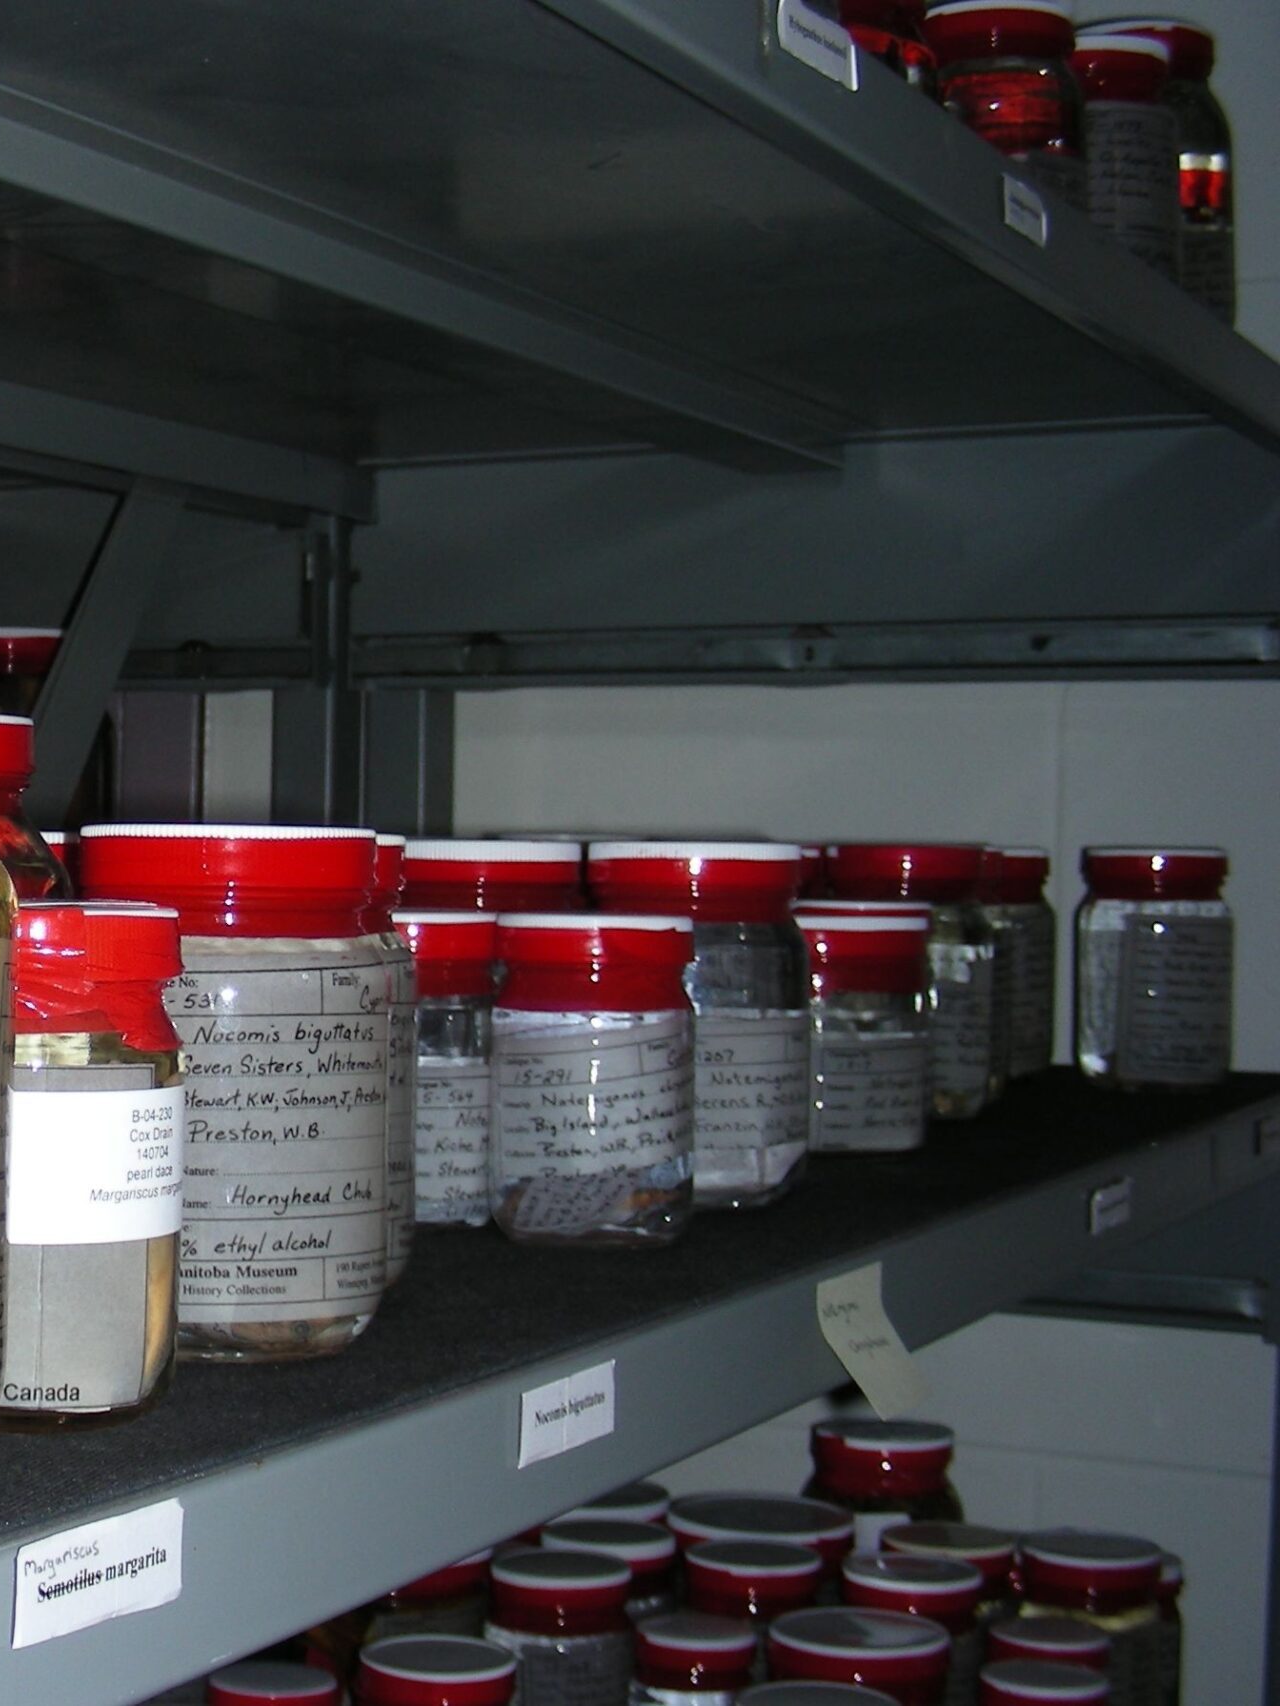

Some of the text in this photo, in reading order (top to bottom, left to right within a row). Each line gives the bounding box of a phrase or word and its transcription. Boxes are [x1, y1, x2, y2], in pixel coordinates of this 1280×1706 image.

[193, 1020, 280, 1044] Nocomis
[184, 1055, 232, 1076] Seven
[129, 1130, 150, 1142] Cox
[187, 1119, 276, 1145] Preston,
[137, 1146, 169, 1160] 140704
[127, 1167, 153, 1183] pearl
[230, 1184, 333, 1217] Hornyhead
[213, 1231, 268, 1261] ethyl
[272, 1229, 332, 1251] alcohol
[236, 1265, 298, 1278] Museum
[183, 1284, 222, 1297] History
[226, 1284, 287, 1295] Collections
[4, 1383, 80, 1402] Canada
[106, 1546, 167, 1579] margarita
